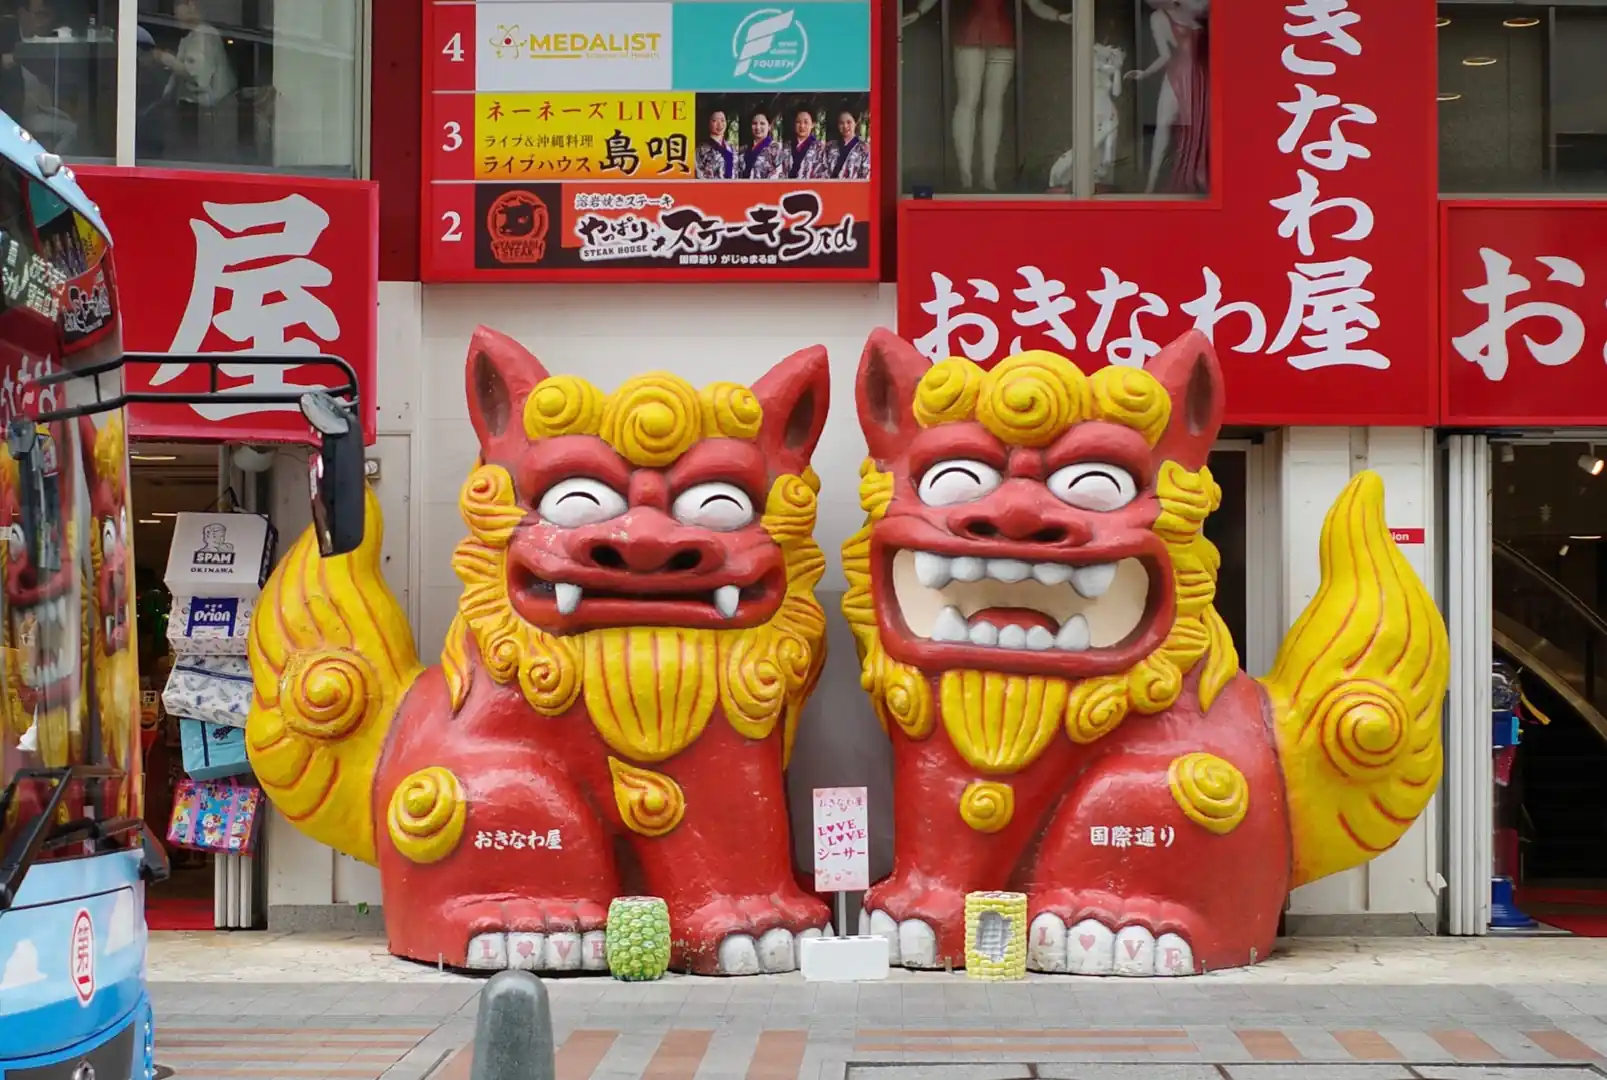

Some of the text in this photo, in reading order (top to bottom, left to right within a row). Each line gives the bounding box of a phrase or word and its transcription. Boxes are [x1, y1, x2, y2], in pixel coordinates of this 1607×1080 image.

[442, 32, 464, 62] 4
[529, 33, 662, 52] MEDALIST
[752, 59, 796, 69] FOURTH
[486, 101, 687, 122] ネーネーズ LIVE
[442, 121, 463, 151] 3
[599, 129, 691, 176] 島唄
[484, 154, 591, 174] ライブハウス
[441, 210, 463, 242] 2
[583, 244, 649, 257] STEAK HOUSE
[149, 193, 341, 421] 屋
[1451, 247, 1607, 381] お
[196, 552, 232, 564] SPAM
[194, 610, 231, 622] Orion
[474, 828, 563, 850] おきなわ屋
[1090, 825, 1176, 848] 国際通り
[817, 847, 866, 861] シーサー
